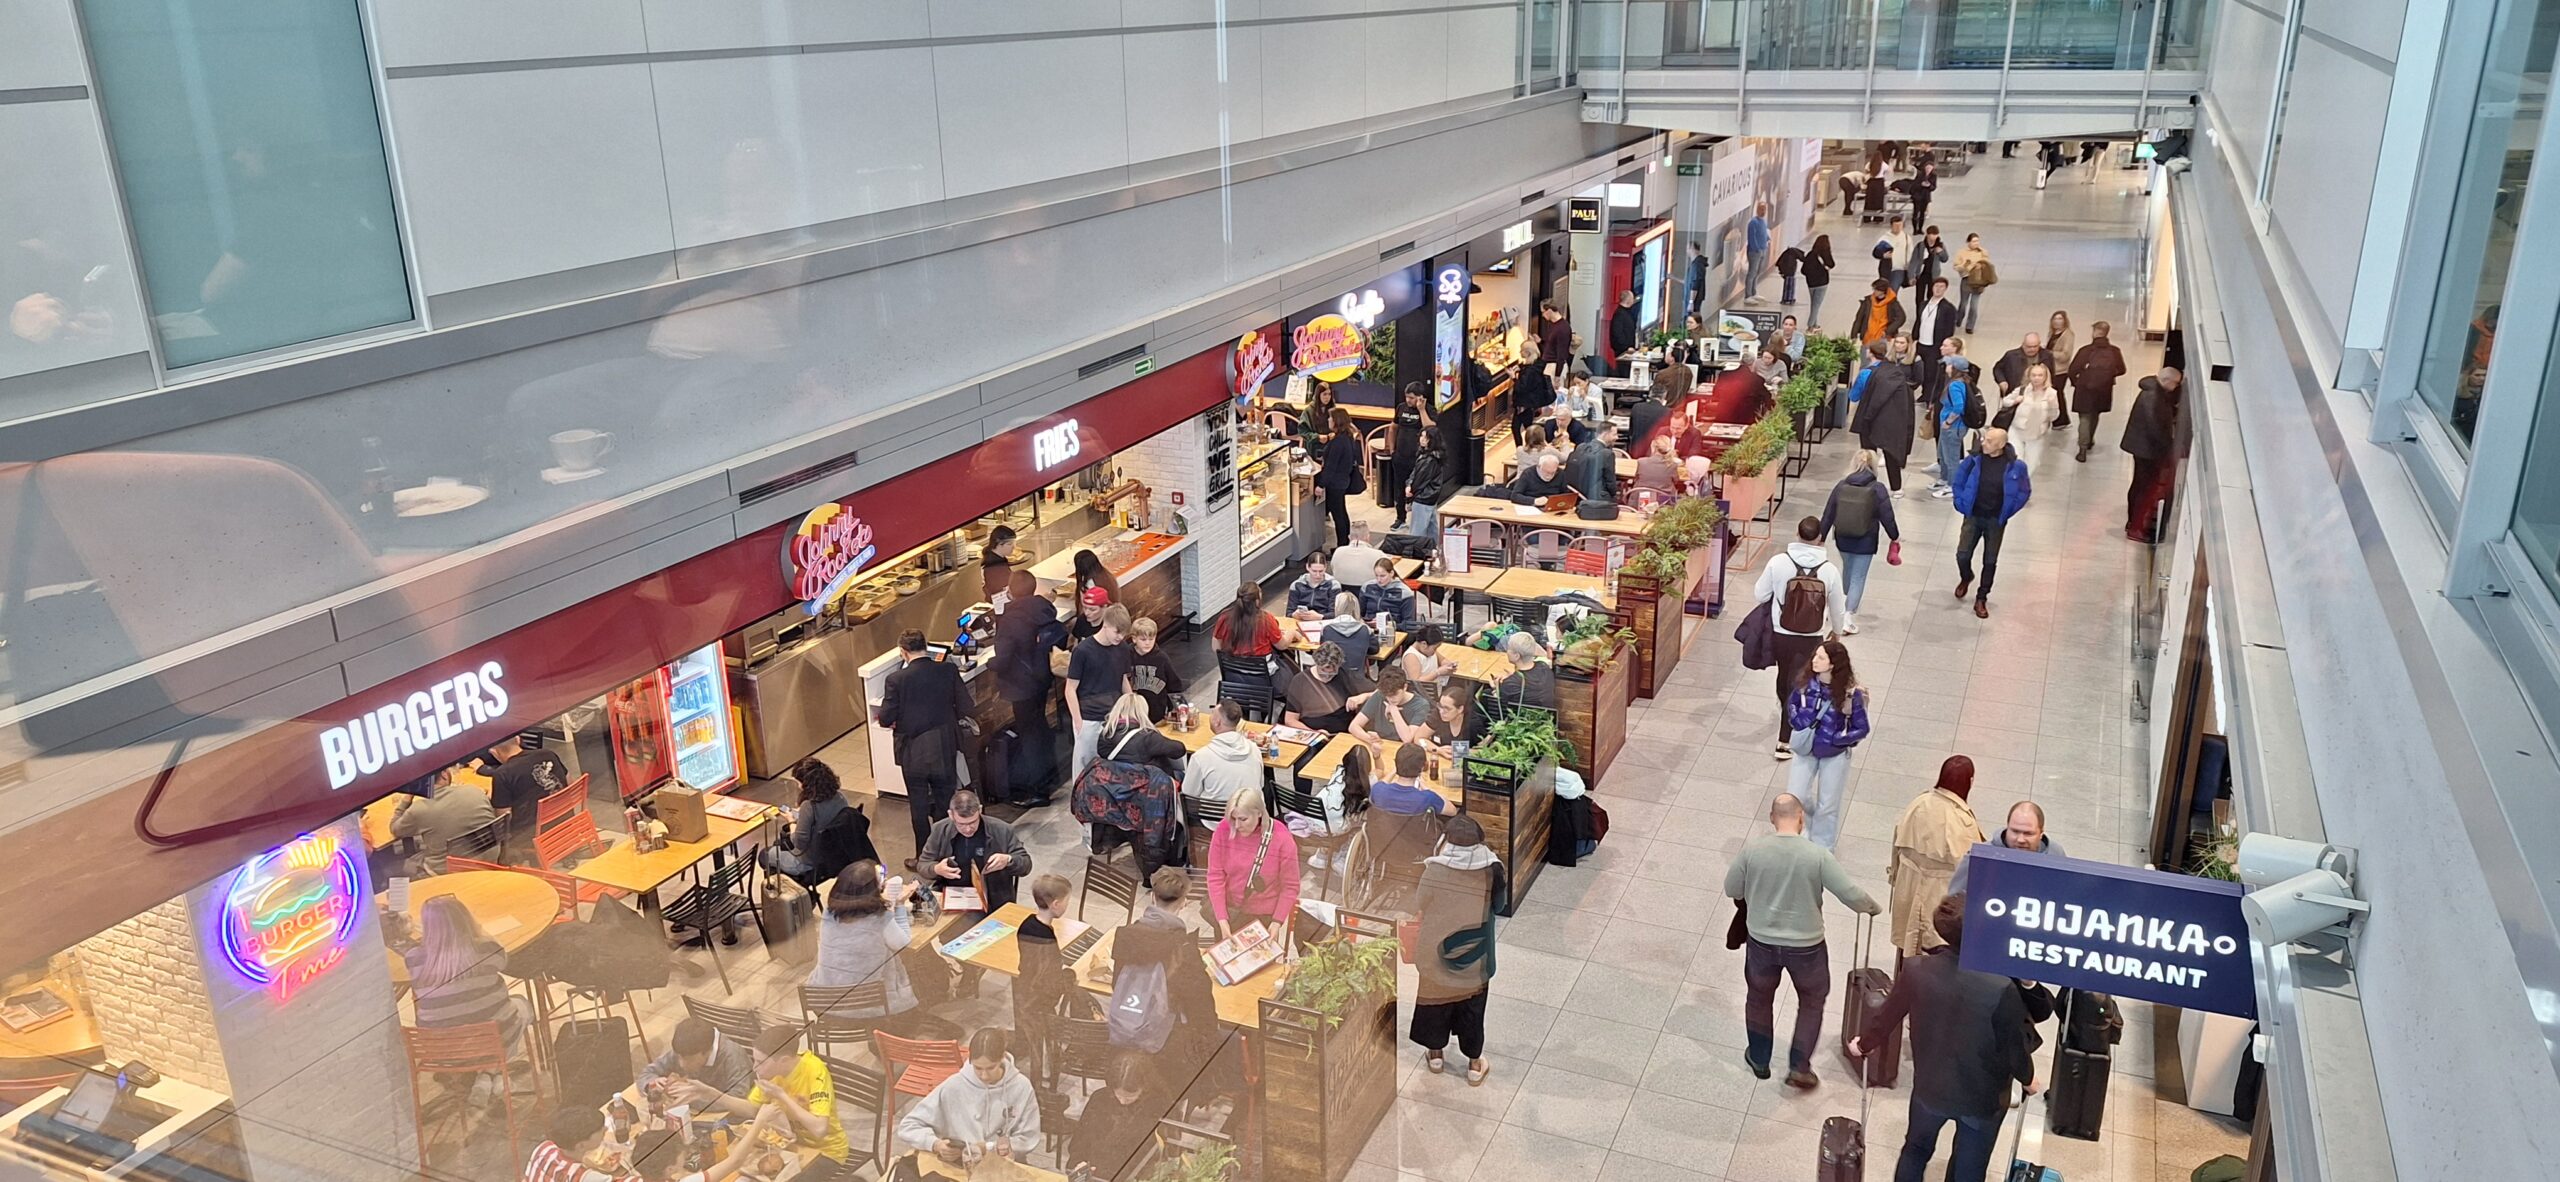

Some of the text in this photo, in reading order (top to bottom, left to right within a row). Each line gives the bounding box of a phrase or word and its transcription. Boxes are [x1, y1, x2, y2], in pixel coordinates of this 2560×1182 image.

[1712, 165, 1752, 207] CAVARIOUS
[1571, 209, 1598, 219] PAUL
[1033, 418, 1080, 472] FRIES
[1207, 409, 1230, 433] YOU
[1207, 447, 1231, 474] WE
[811, 523, 873, 600] Rockets
[319, 660, 509, 790] BURGERS
[244, 894, 344, 955] BURGER
[2011, 896, 2211, 956] BIJANKA
[2008, 937, 2208, 989] RESTAURANT
